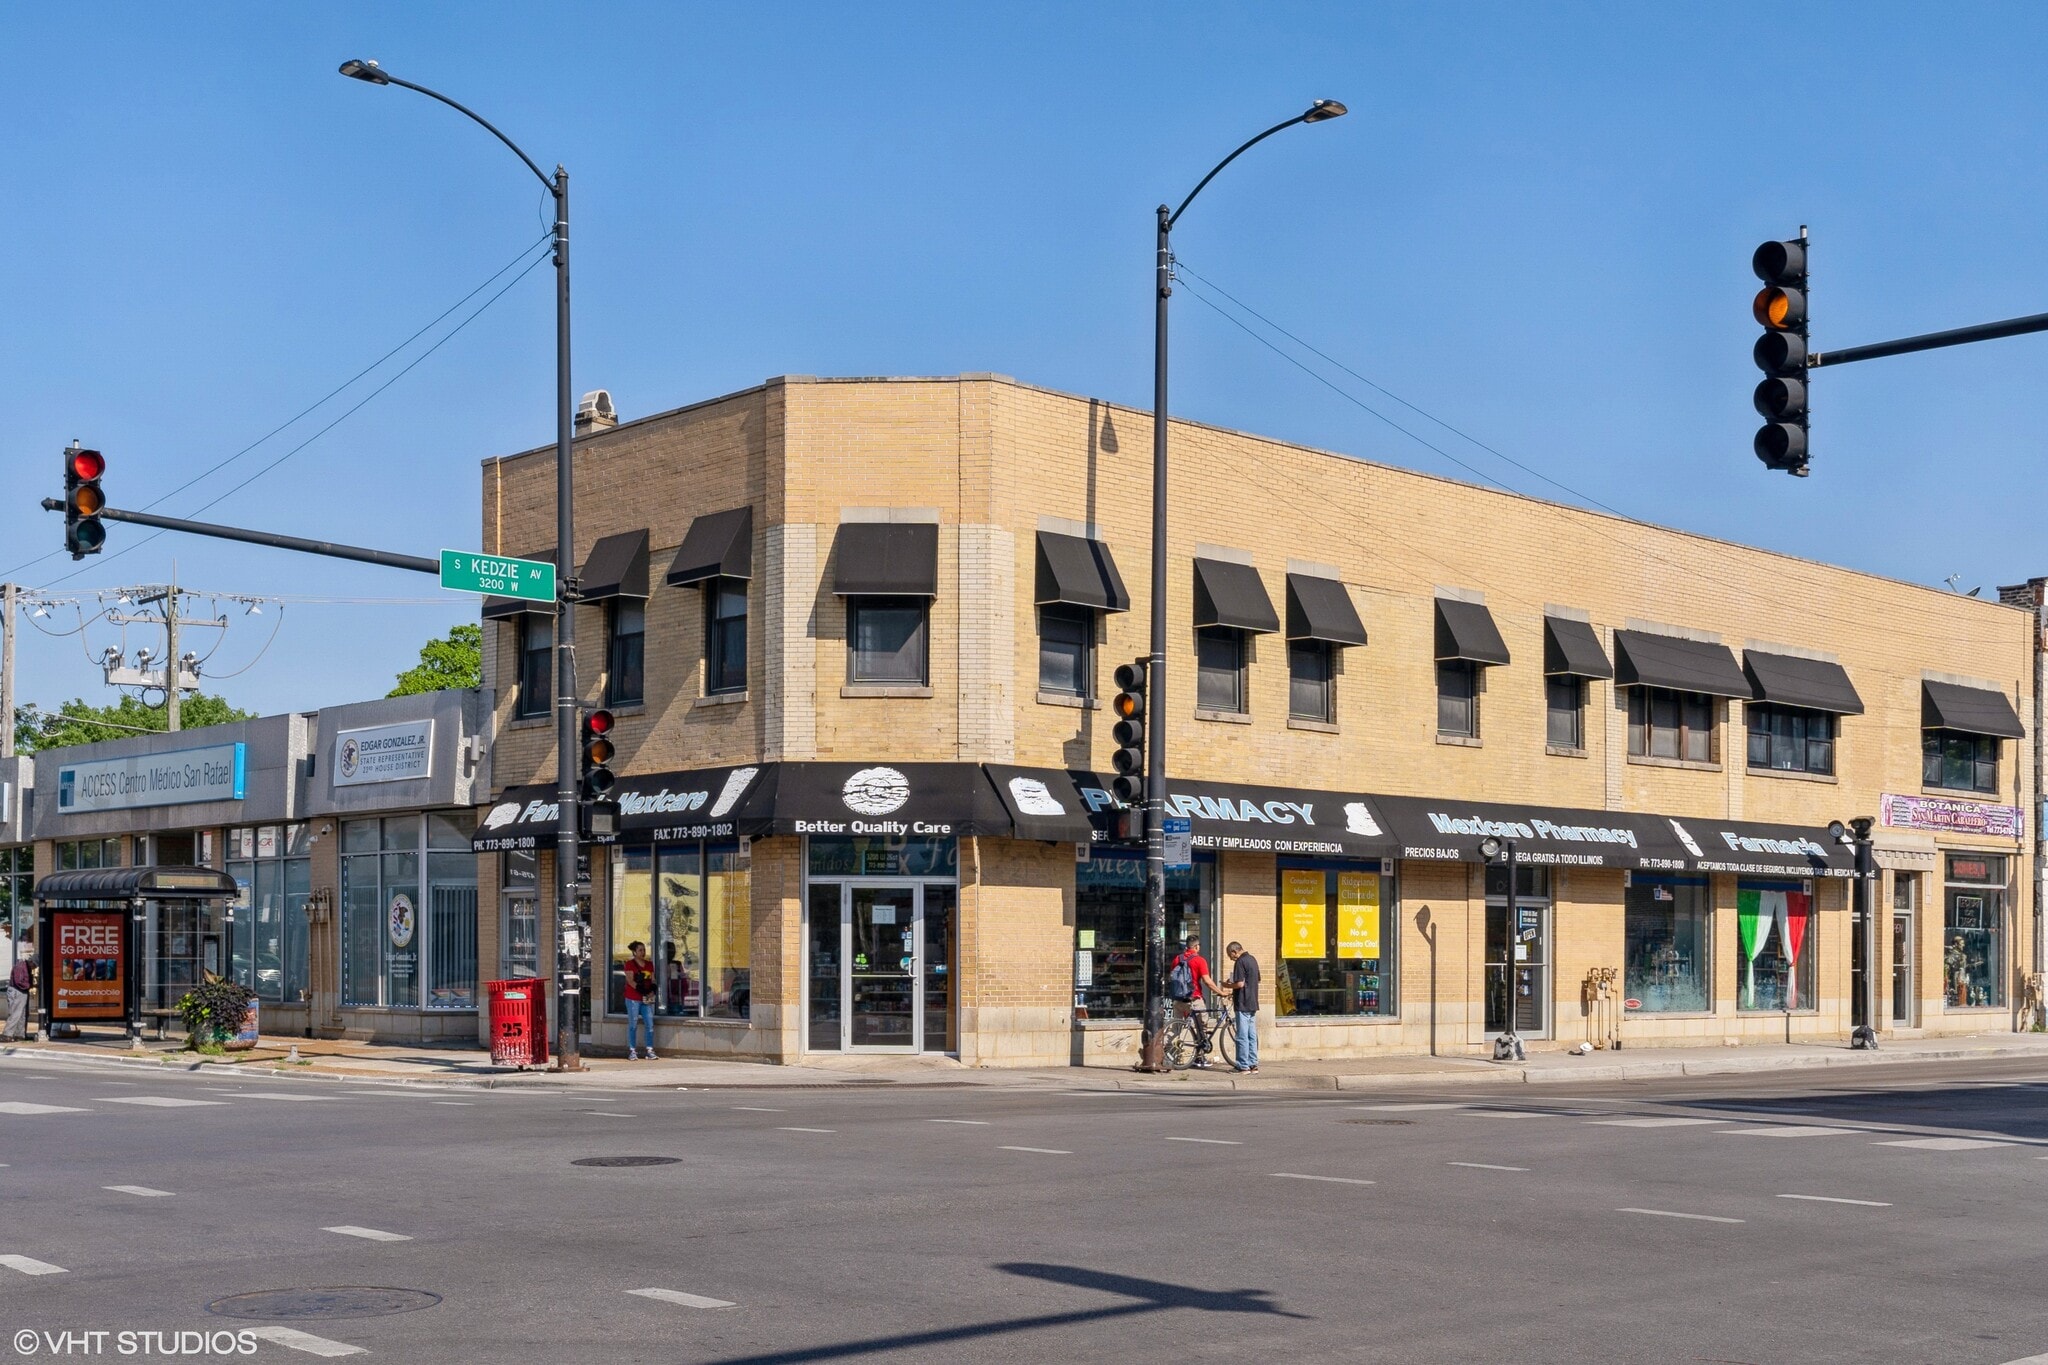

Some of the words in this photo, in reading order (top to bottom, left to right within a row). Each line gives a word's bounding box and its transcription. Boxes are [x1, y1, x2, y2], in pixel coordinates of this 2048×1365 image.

[455, 559, 461, 570] S
[471, 558, 519, 579] KEDZIE
[530, 569, 542, 580] AV
[479, 577, 504, 590] 3200
[511, 582, 519, 592] W
[360, 739, 383, 752] EDGAR
[360, 756, 376, 766] STATE
[378, 751, 425, 763] REPRESENTATIVE
[375, 763, 394, 773] HOUSE
[395, 760, 421, 771] DISTRICT
[81, 772, 117, 798] ACCESS
[118, 771, 147, 795] Centro
[149, 766, 181, 791] Médico
[183, 763, 201, 788] San
[203, 759, 232, 787] Rafael
[1080, 786, 1316, 826] PRMACY
[1919, 799, 1982, 814] BOTANICA
[653, 828, 671, 841] FAX:
[672, 822, 733, 839] 773-890-1802
[795, 820, 847, 833] Better
[851, 820, 908, 835] Quality
[913, 821, 951, 834] Care
[1427, 812, 1535, 839] Mexicare
[1529, 818, 1638, 849] Pharmacy
[486, 836, 535, 850] 773-890-1800
[1215, 836, 1222, 847] Y
[1222, 837, 1272, 850] EMPLEADOS
[1274, 840, 1292, 851] CON
[1293, 841, 1343, 853] EXPERIENCIA
[1719, 831, 1829, 857] Farmacia
[1405, 846, 1435, 858] PRECIOS
[1436, 848, 1459, 859] BAJOS
[1532, 852, 1555, 863] GRATIS
[1556, 854, 1561, 863] A
[1561, 854, 1578, 864] TODO
[1578, 855, 1603, 866] ILLINOIS
[1696, 860, 1726, 871] ACEPTAMOS
[1726, 862, 1740, 872] TODA
[1740, 863, 1756, 872] CLASE
[1756, 864, 1762, 873] DE
[1341, 876, 1375, 889] Ridgeland
[1366, 890, 1375, 899] de
[60, 925, 119, 945] FREE
[1350, 928, 1360, 937] No
[1361, 929, 1368, 937] se
[60, 945, 75, 955] 5G
[76, 945, 119, 955] PHONES
[501, 1022, 523, 1038] 25
